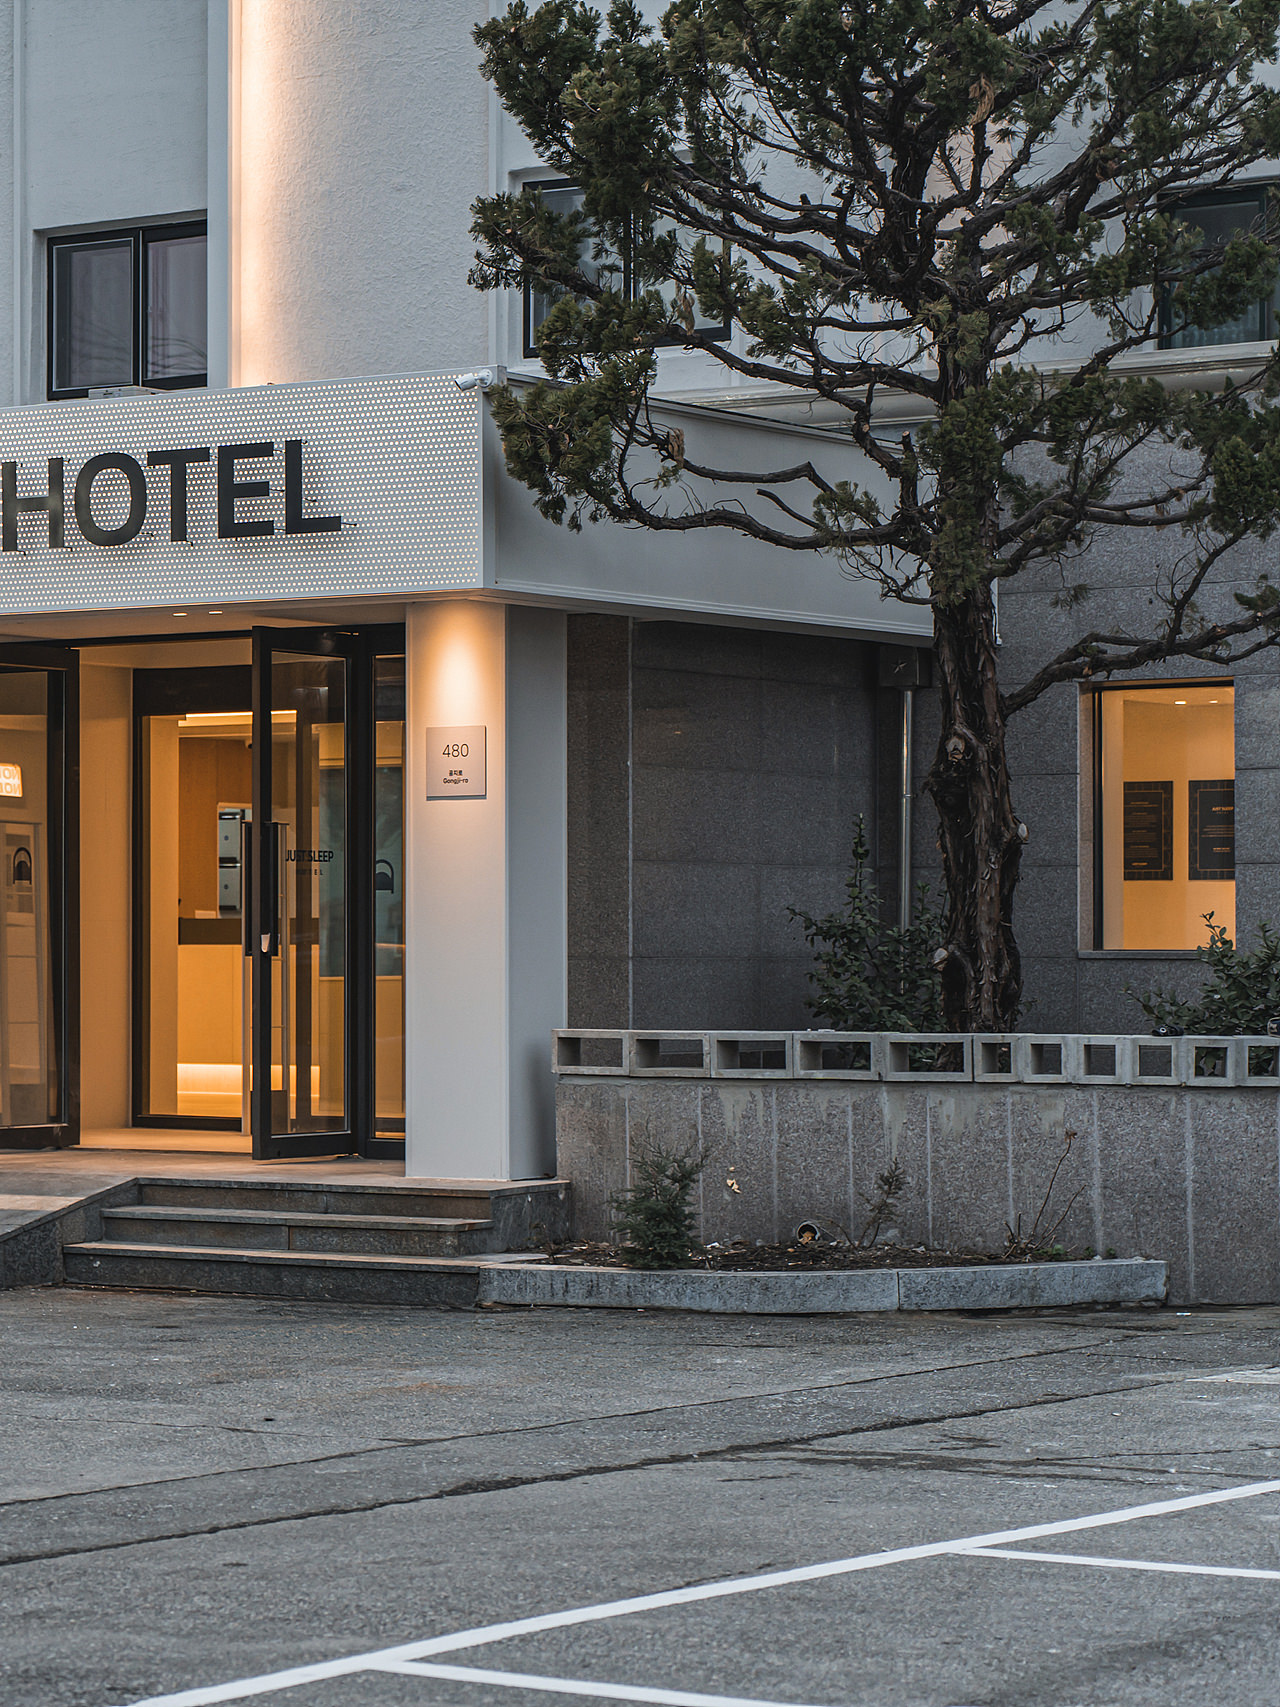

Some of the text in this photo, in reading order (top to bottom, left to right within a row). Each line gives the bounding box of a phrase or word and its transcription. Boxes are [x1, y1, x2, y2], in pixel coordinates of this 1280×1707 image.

[1, 439, 342, 553] HOTEL
[442, 743, 469, 758] 480
[307, 850, 334, 862] SLEEP
